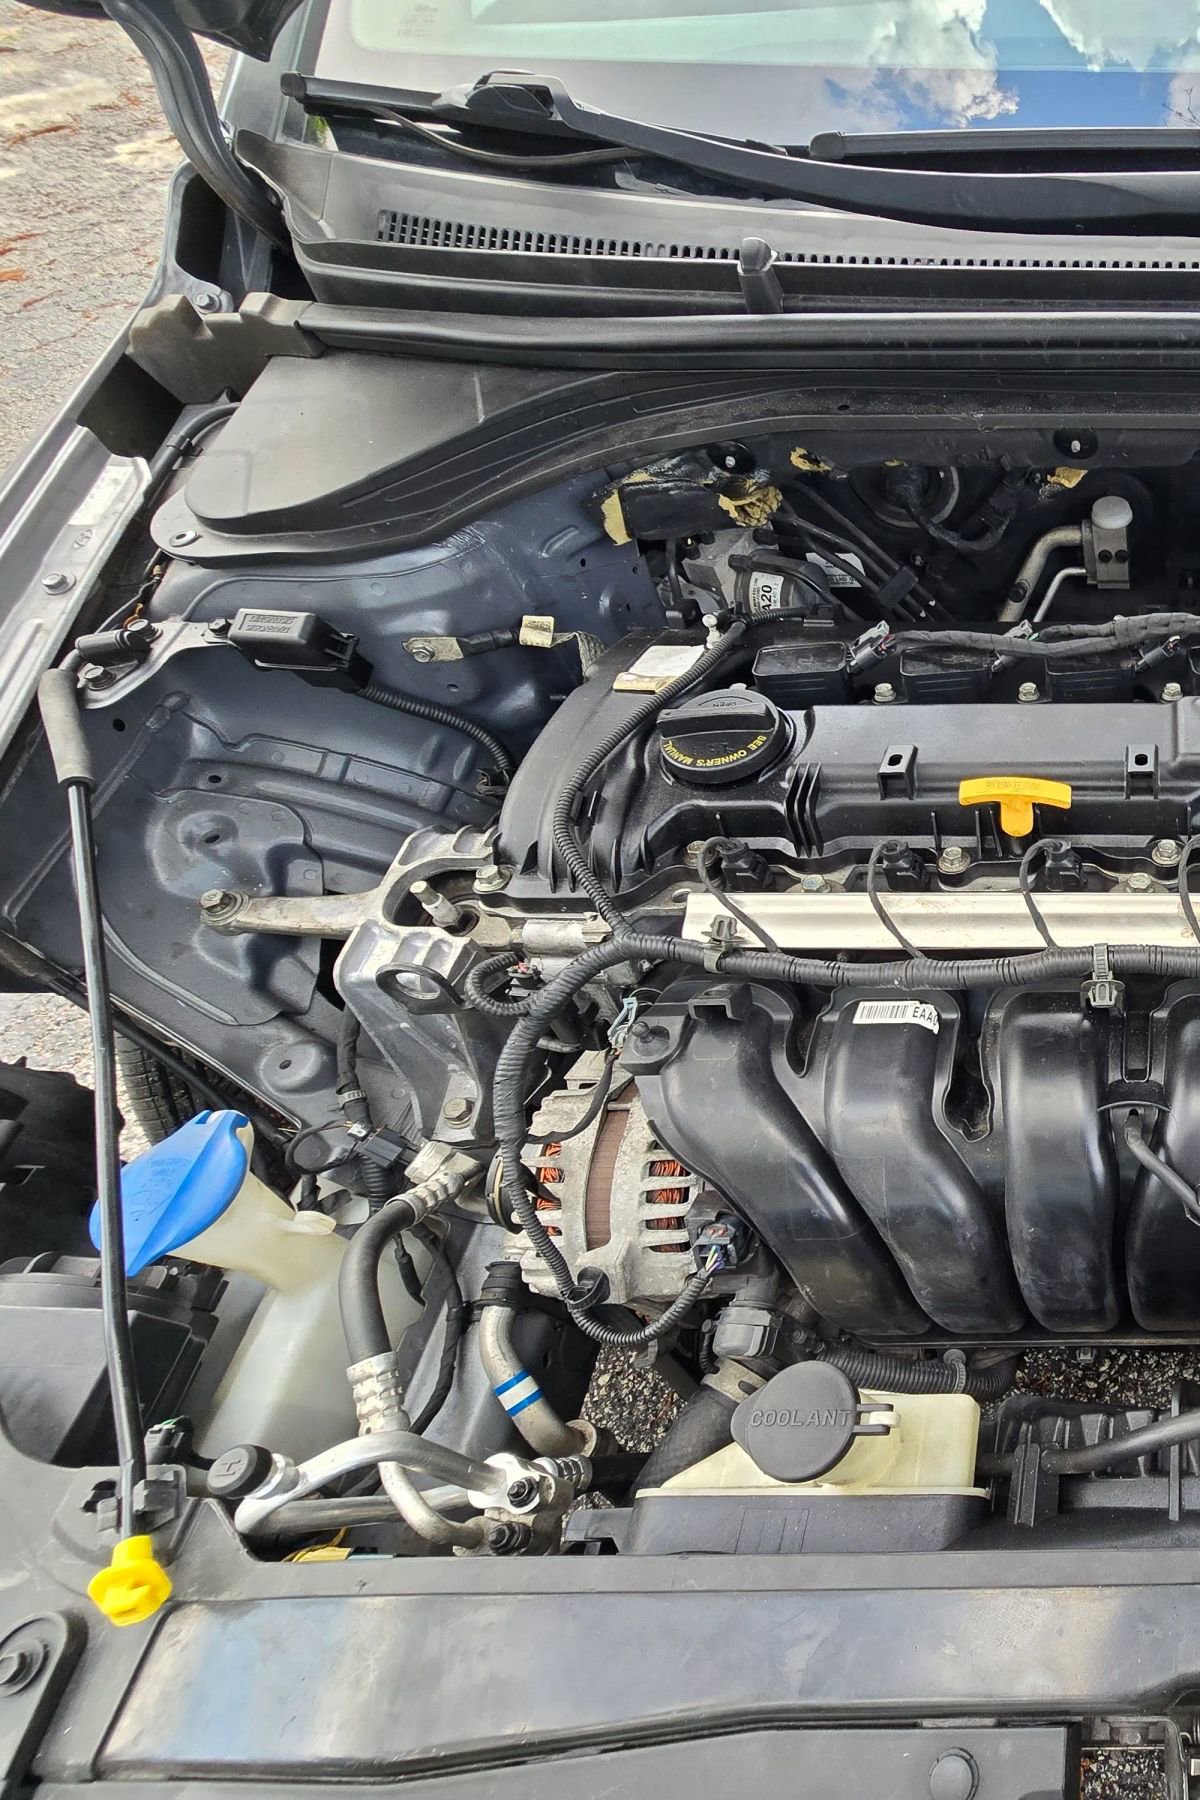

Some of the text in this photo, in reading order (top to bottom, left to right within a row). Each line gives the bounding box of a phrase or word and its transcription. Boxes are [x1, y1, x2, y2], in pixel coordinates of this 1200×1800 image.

[663, 735, 767, 767] SEE OWNER'S MANUAL
[751, 1409, 852, 1428] COOLANT
